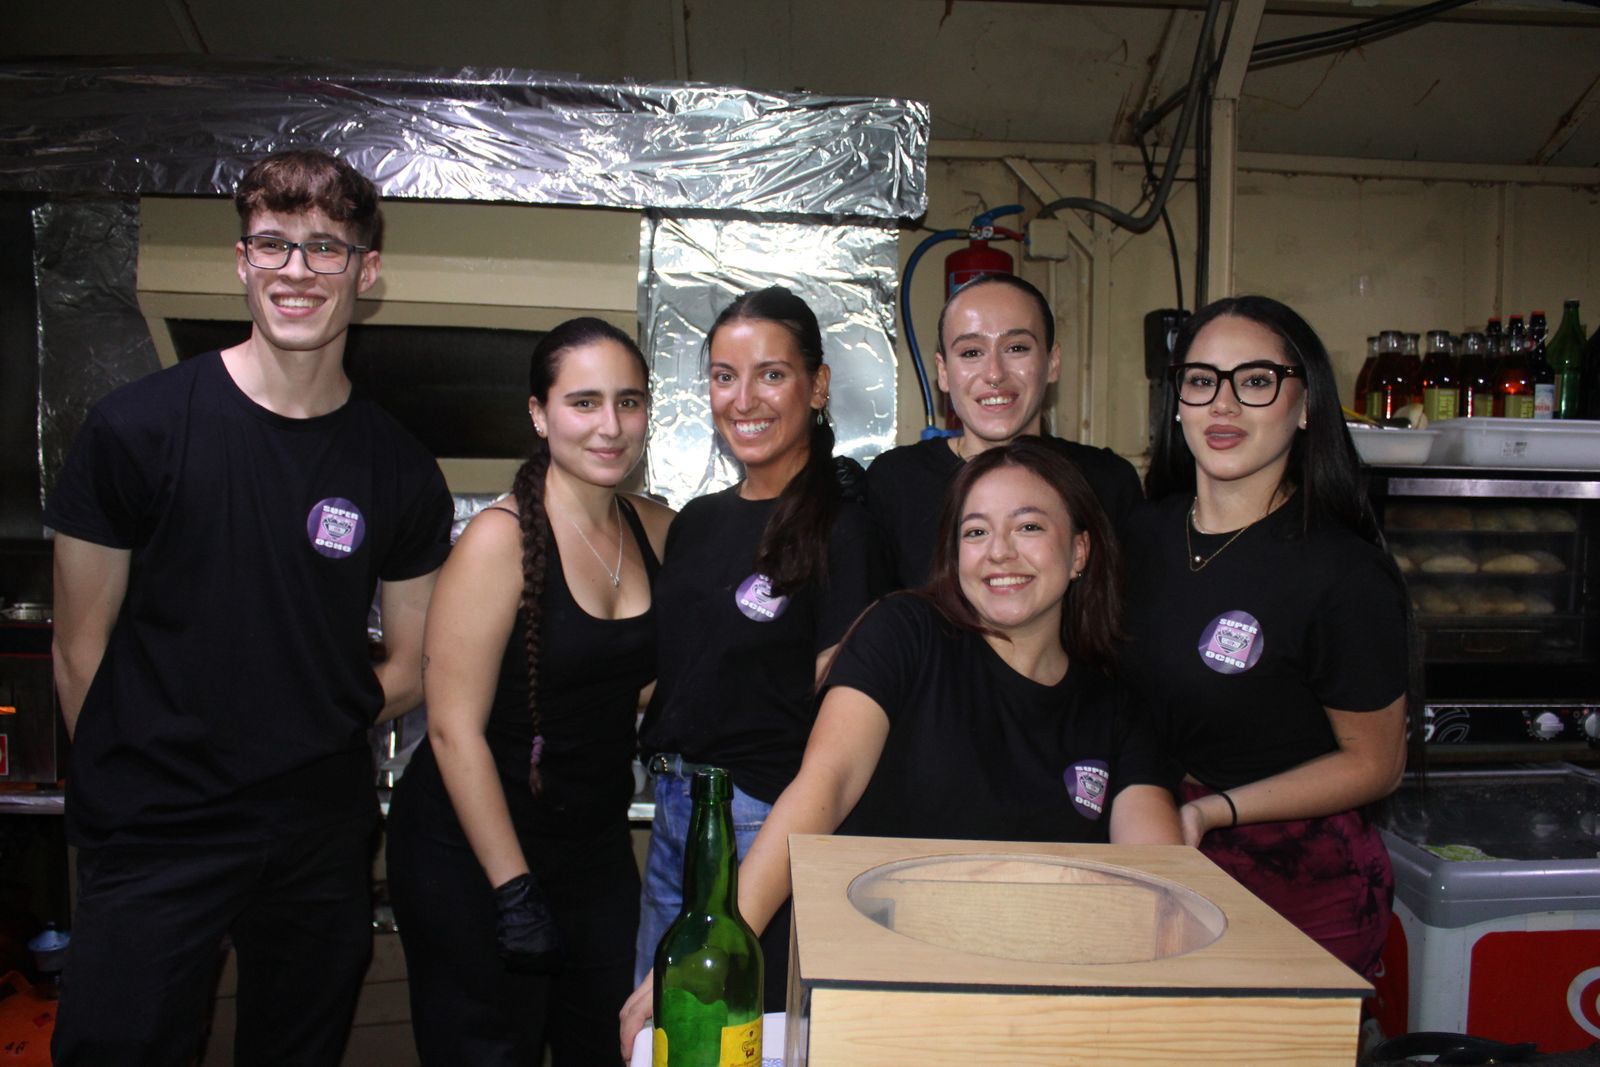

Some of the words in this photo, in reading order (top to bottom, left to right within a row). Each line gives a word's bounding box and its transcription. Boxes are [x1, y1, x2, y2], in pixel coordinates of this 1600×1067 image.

[322, 505, 358, 520] SUPER
[315, 538, 352, 553] OCHO
[740, 598, 775, 618] OCHO
[1219, 618, 1258, 635] SUPER
[1205, 650, 1246, 669] OCHO
[1075, 766, 1109, 780] SUPER
